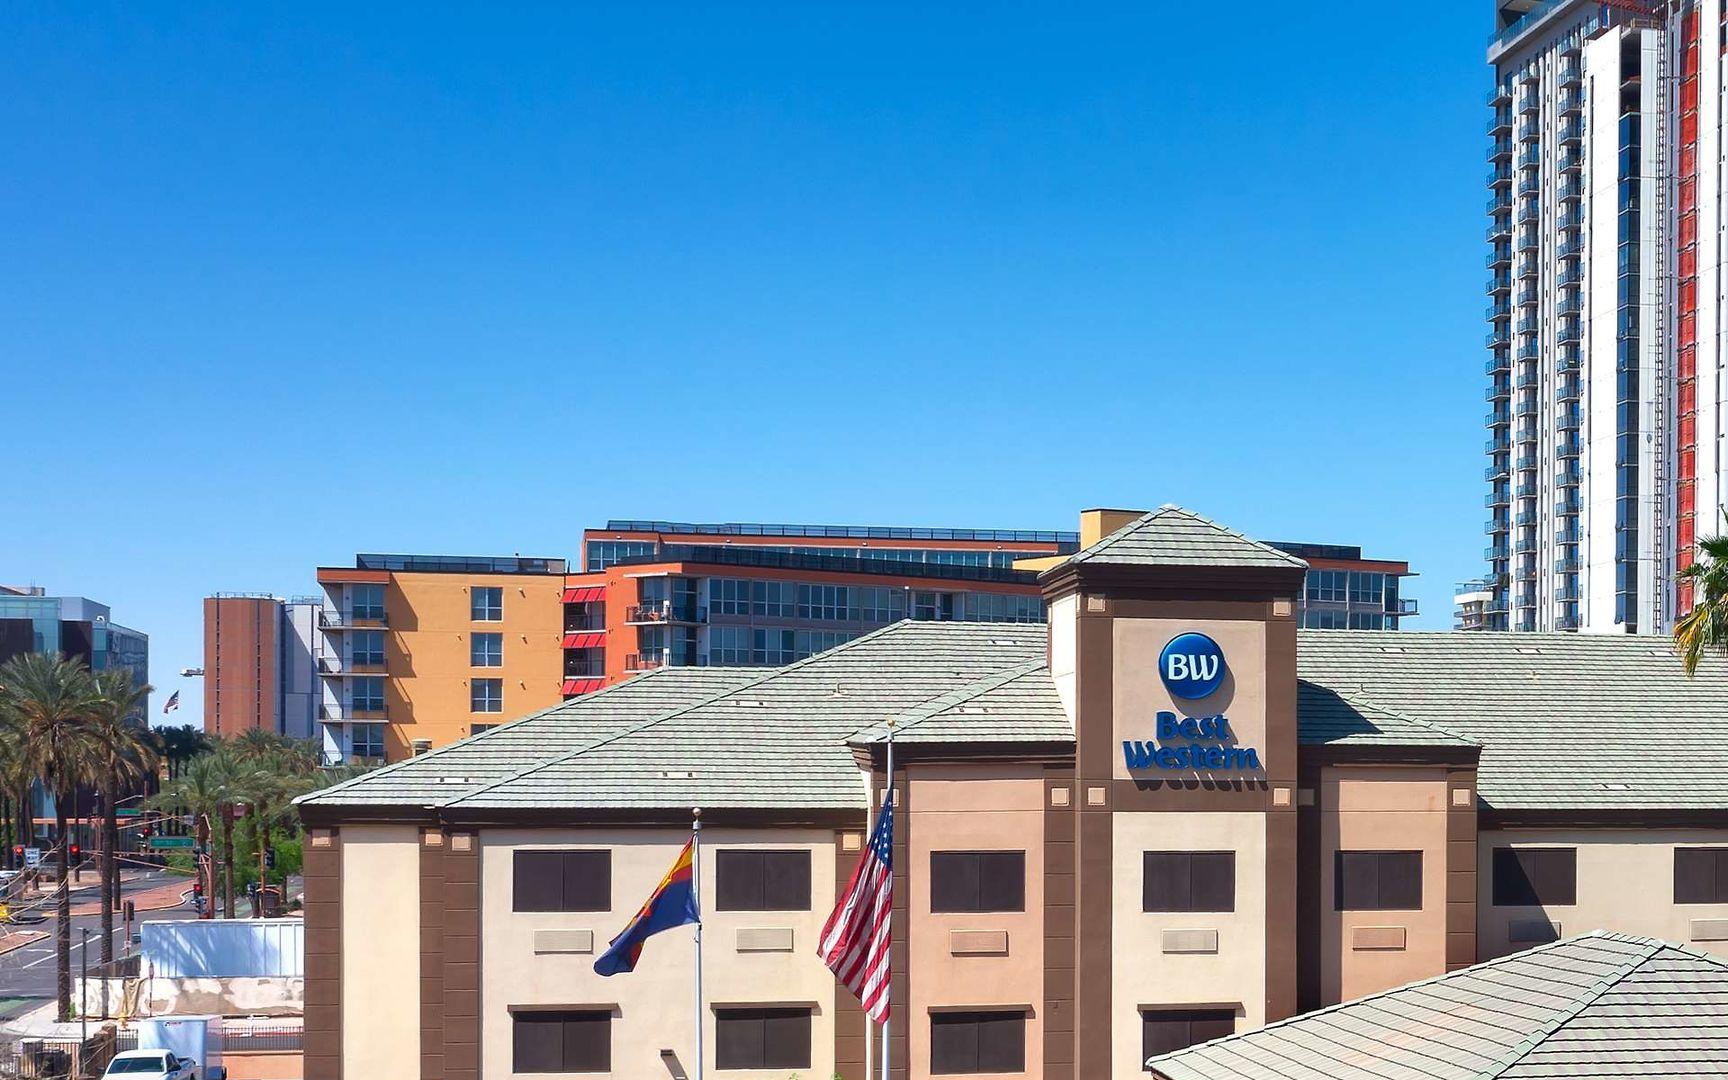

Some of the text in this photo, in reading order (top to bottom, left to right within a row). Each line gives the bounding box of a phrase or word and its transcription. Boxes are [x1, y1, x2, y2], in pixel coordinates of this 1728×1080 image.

[1168, 654, 1218, 680] BW
[1156, 711, 1228, 740] Best
[1122, 741, 1258, 769] Western
